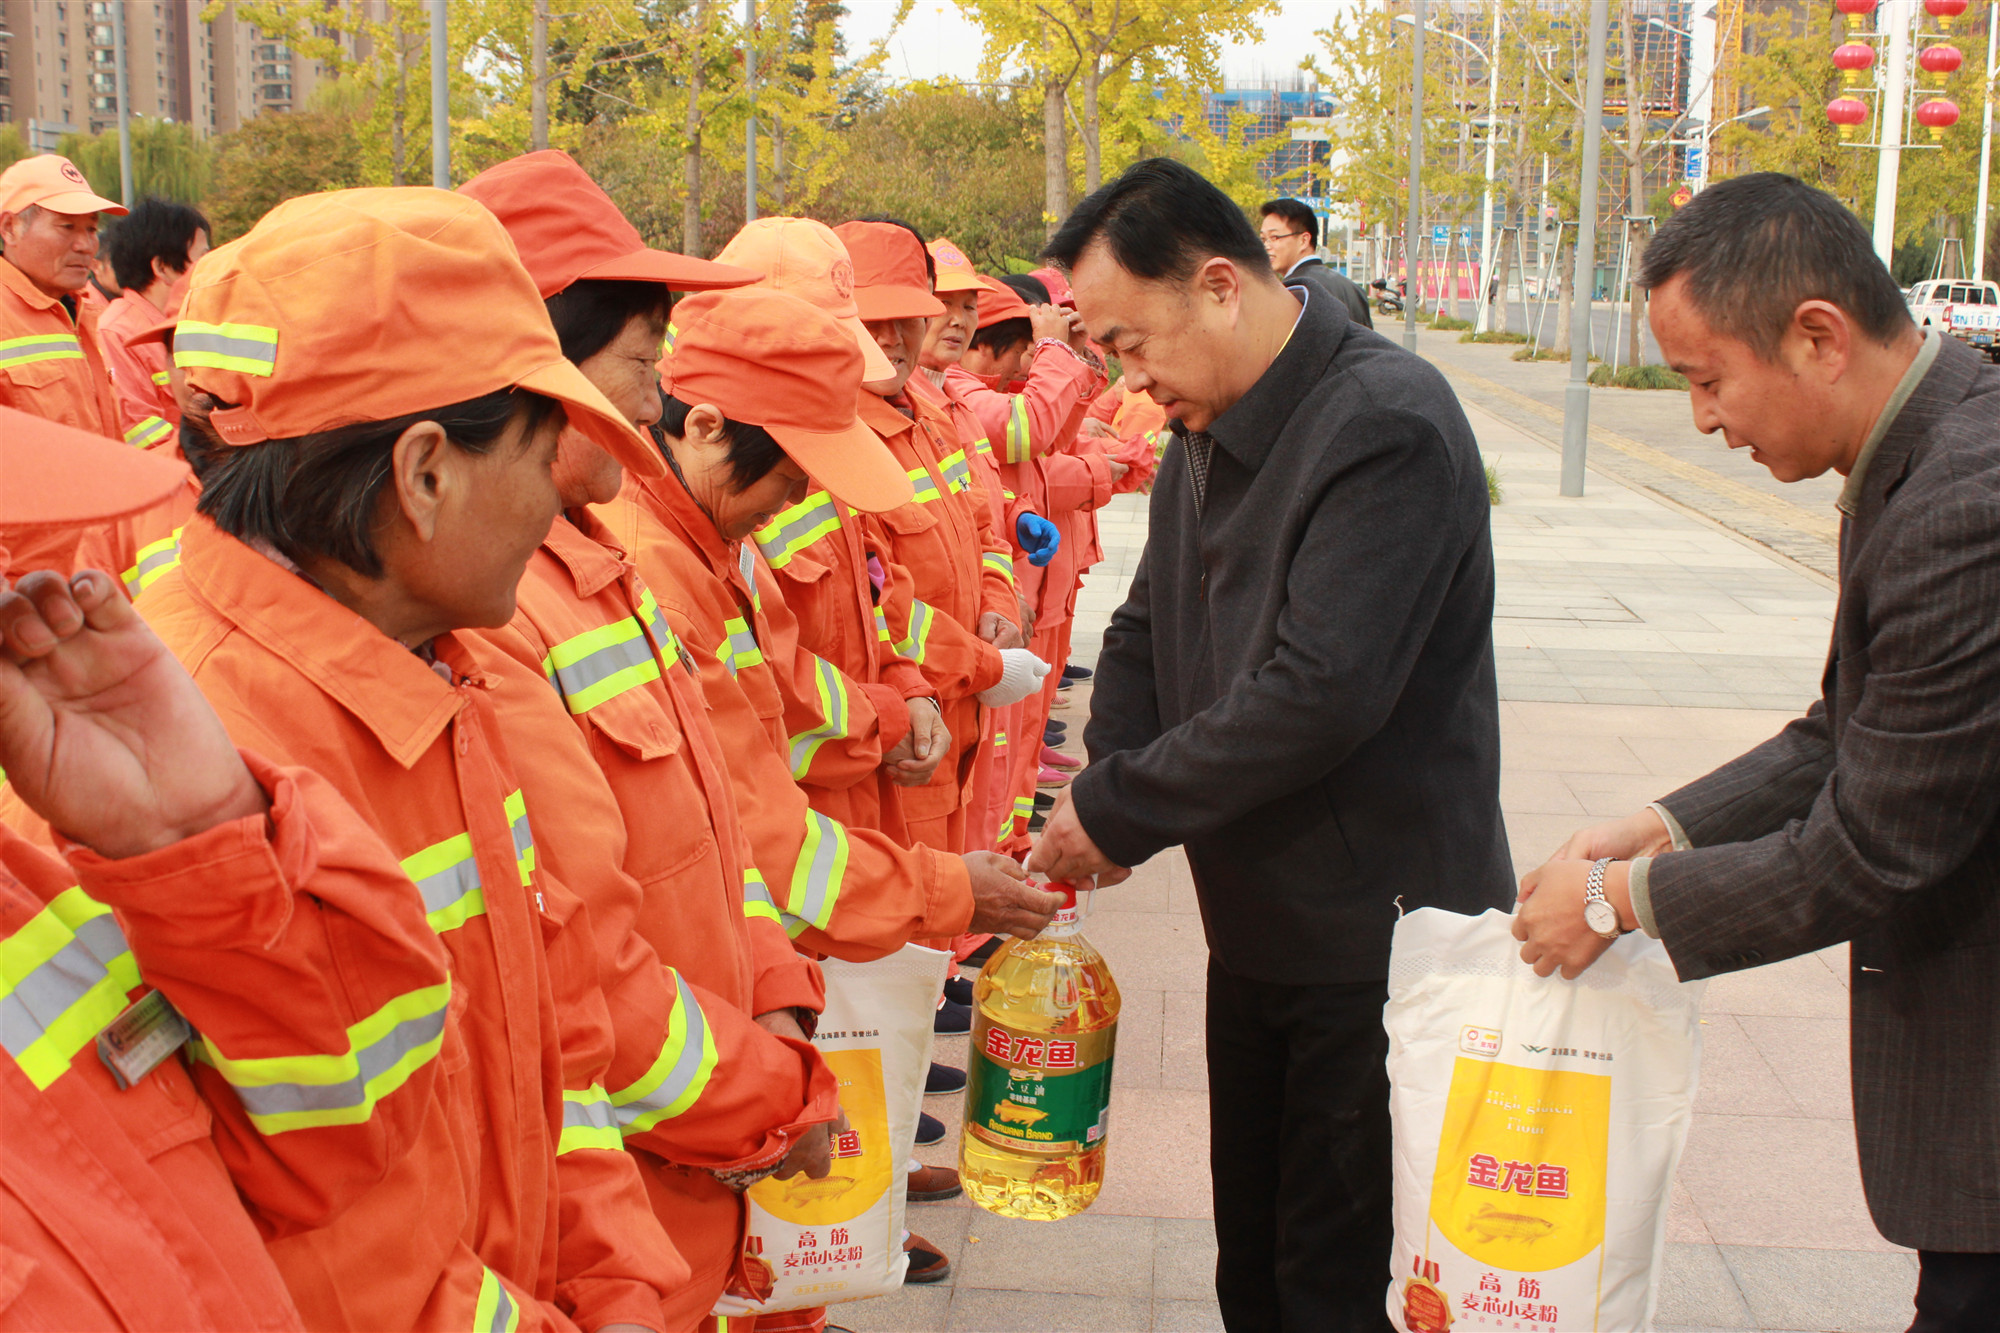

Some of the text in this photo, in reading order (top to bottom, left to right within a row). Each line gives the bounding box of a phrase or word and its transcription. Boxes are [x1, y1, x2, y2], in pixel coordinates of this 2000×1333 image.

[986, 1027, 1077, 1068] 金龙鱼
[1007, 1079, 1045, 1096] 大豆油
[830, 1129, 862, 1159] 鱼
[1467, 1152, 1569, 1198] 金龙鱼
[783, 1245, 863, 1269] 麦芯小麦粉
[1461, 1289, 1559, 1323] 麦芯小麦粉
